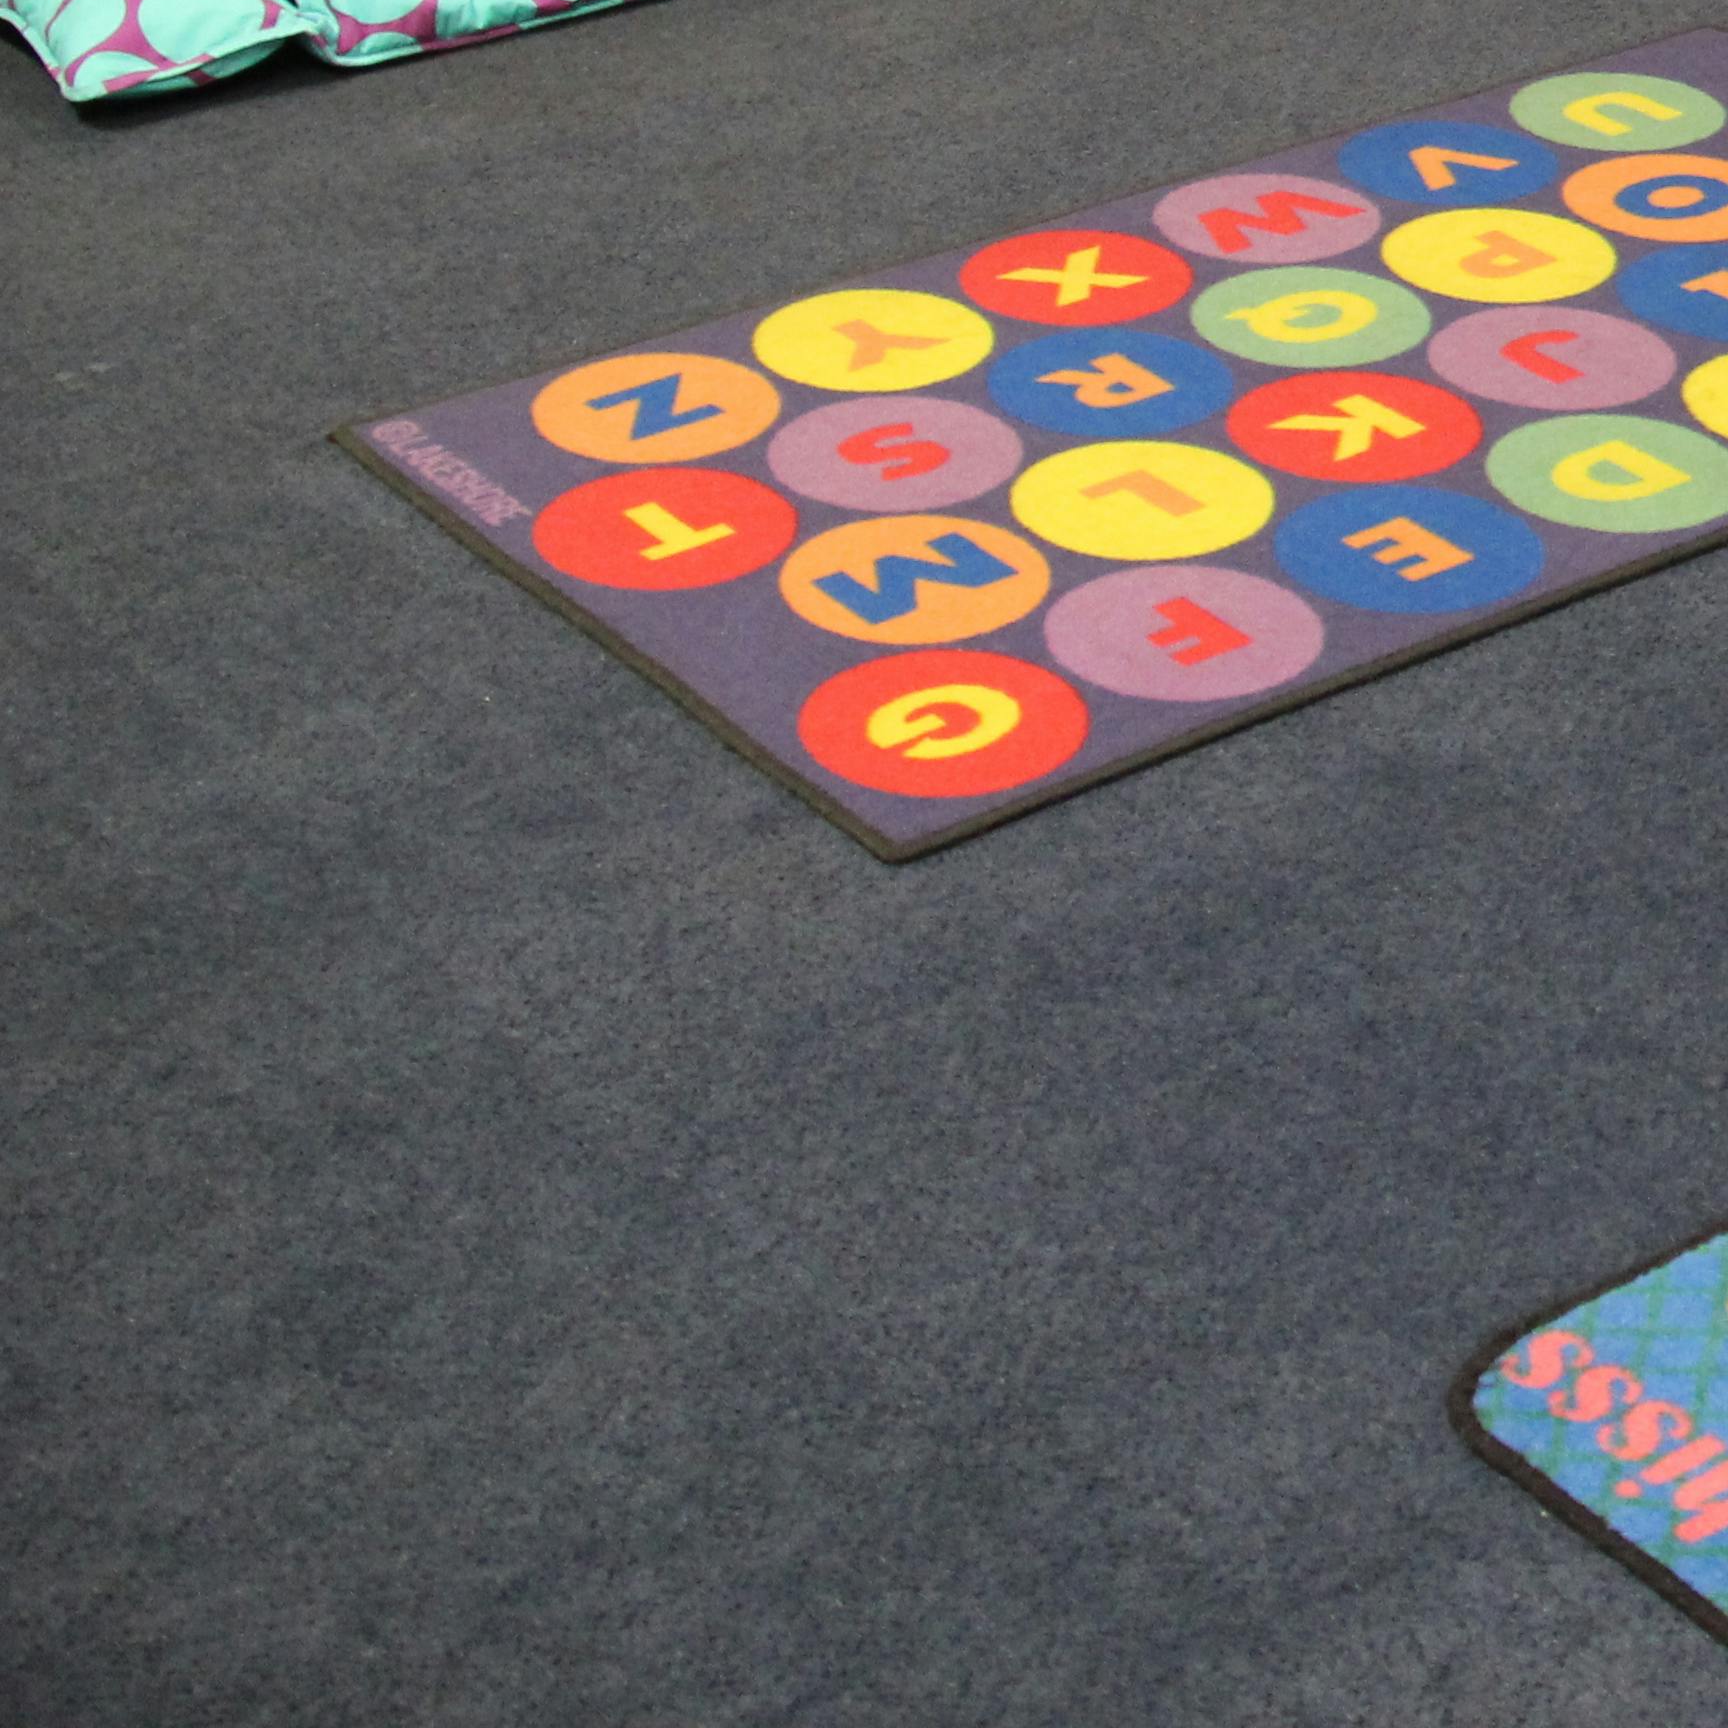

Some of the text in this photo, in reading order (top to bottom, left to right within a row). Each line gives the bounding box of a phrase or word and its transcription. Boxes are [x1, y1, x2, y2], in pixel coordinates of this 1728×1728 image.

[587, 92, 1681, 440] U V W X Y Z
[1460, 230, 1556, 278] P
[1228, 290, 1377, 342] Q
[1039, 354, 1173, 407] R
[1501, 330, 1585, 383] J
[837, 423, 950, 480] S
[1273, 395, 1424, 460] K
[1081, 470, 1204, 516] L
[1552, 440, 1690, 501] D
[626, 503, 733, 560] T
[1344, 517, 1472, 580] E
[814, 533, 1017, 624] M
[1148, 597, 1251, 666] F
[868, 685, 1020, 759] G
